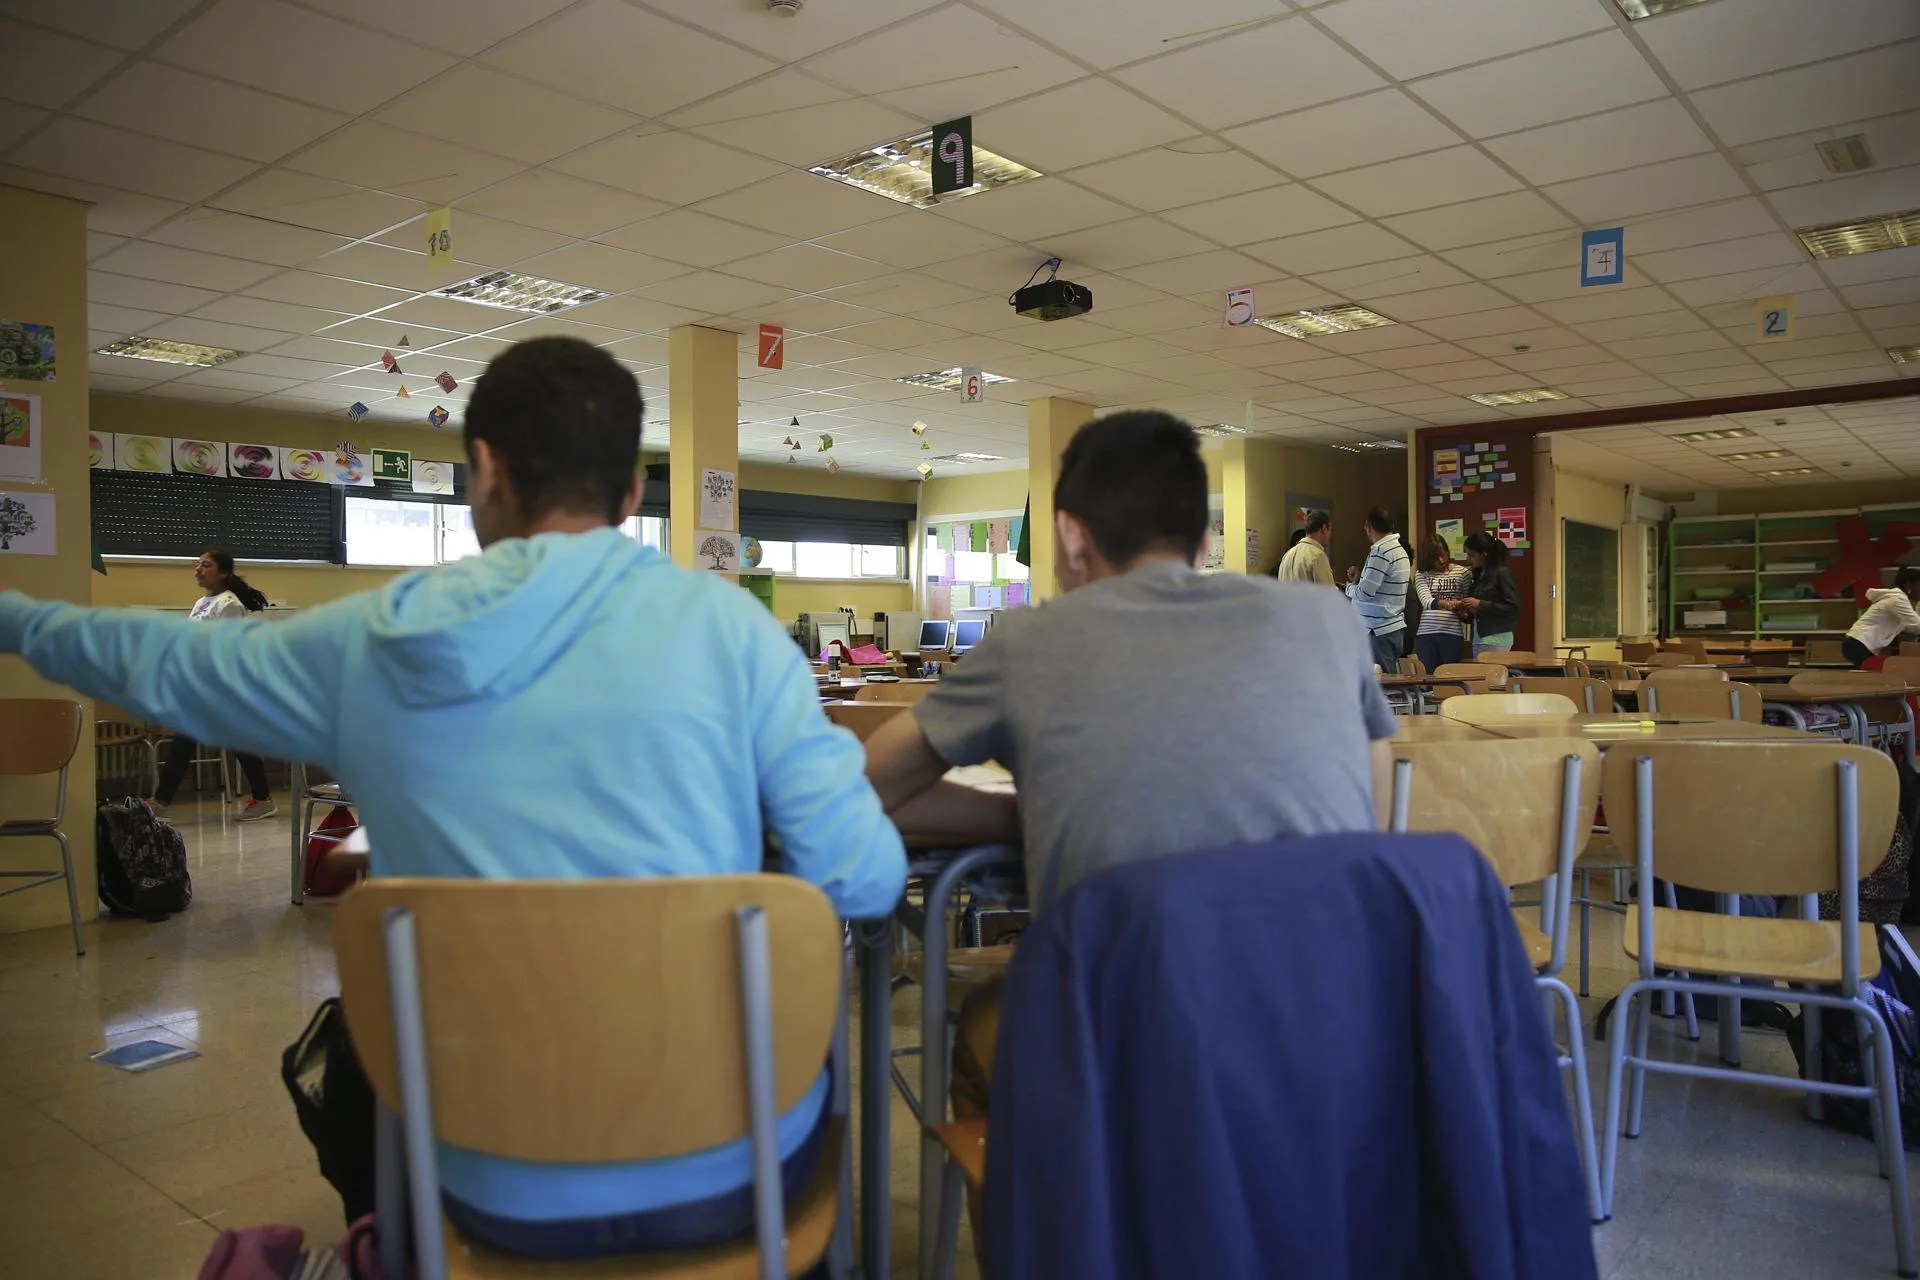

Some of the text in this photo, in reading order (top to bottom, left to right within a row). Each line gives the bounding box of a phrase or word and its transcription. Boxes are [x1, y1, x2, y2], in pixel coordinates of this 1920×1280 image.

[938, 132, 964, 184] 9
[427, 229, 451, 256] 10
[1227, 289, 1253, 326] 5
[1766, 311, 1786, 335] 2
[760, 330, 783, 367] 7
[967, 375, 978, 396] 6
